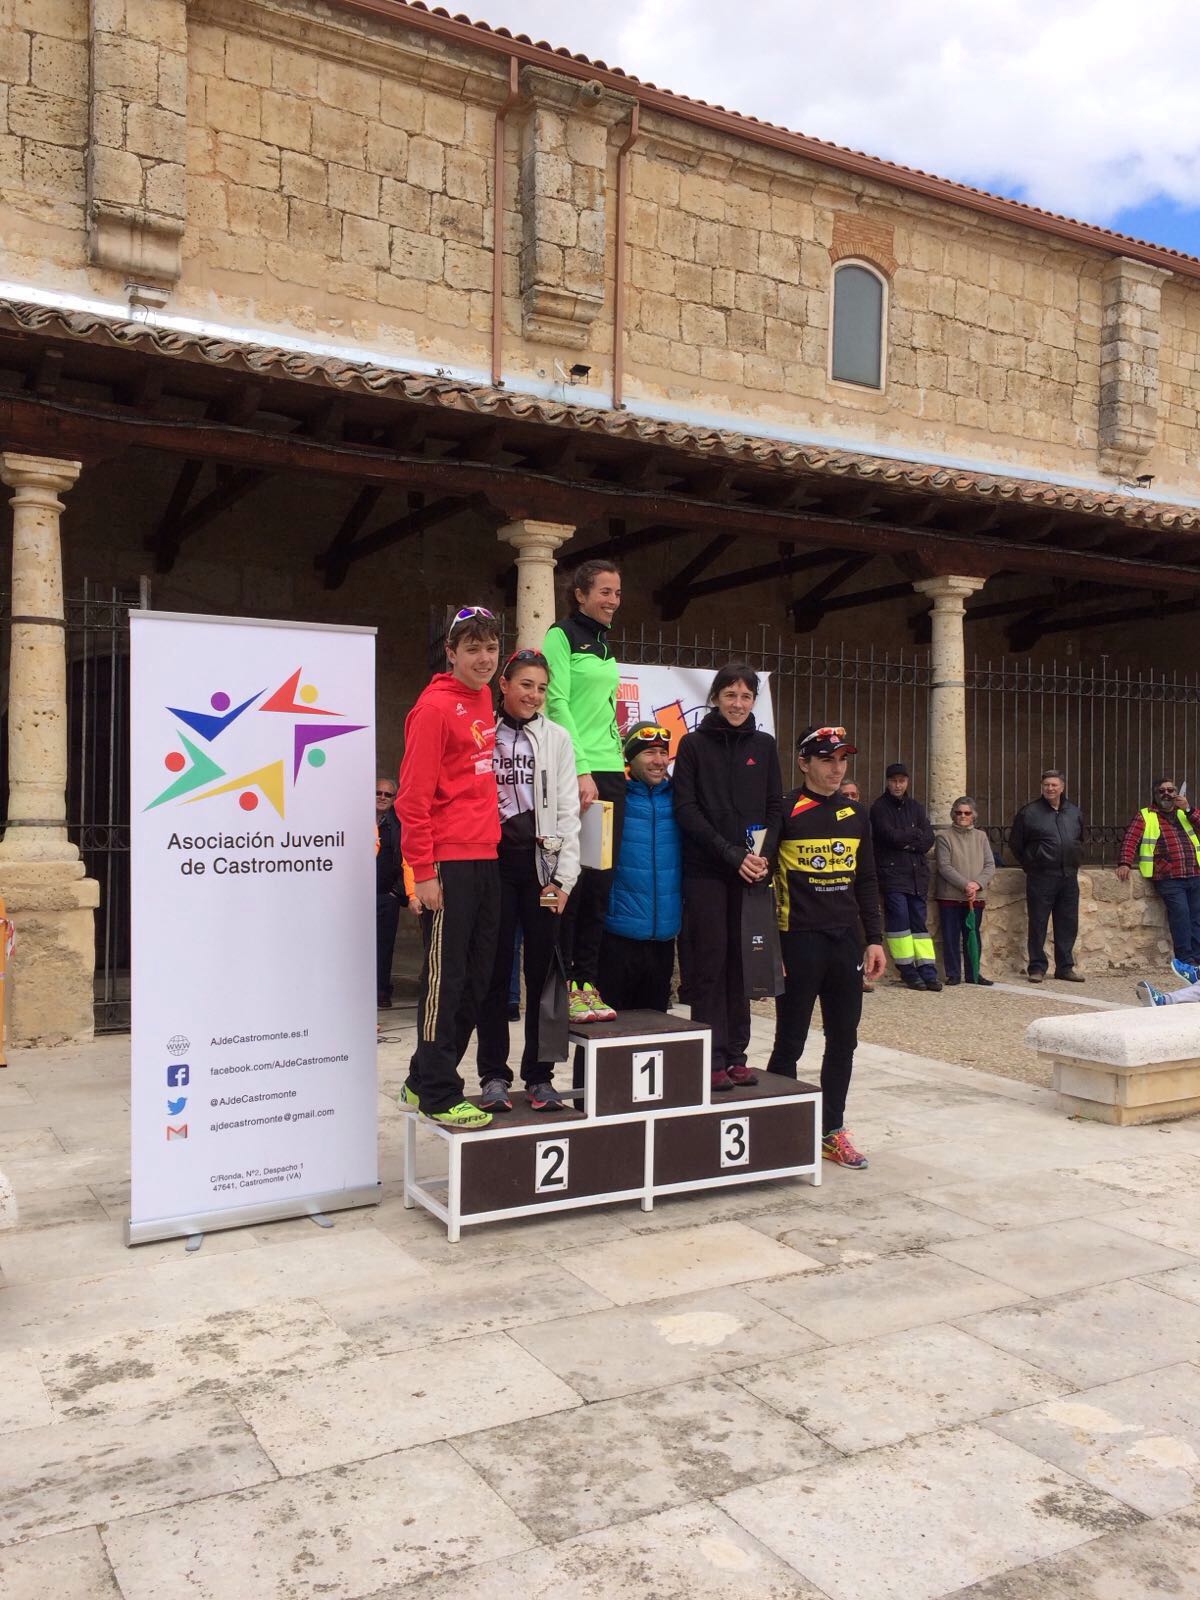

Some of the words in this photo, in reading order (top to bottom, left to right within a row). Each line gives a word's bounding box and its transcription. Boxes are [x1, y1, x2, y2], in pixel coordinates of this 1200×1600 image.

[616, 683, 638, 700] smo
[495, 769, 534, 785] uélla
[167, 832, 274, 850] Asociación
[280, 831, 345, 848] Juvenil
[180, 858, 206, 875] de
[213, 857, 333, 874] Castromonte
[210, 1053, 349, 1076] facebook.com/AJdeCastromonte
[640, 1056, 656, 1096] 1
[210, 1108, 335, 1133] ajdecastromonte@gmail.com
[724, 1123, 746, 1161] 3
[540, 1145, 564, 1187] 2
[239, 1174, 285, 1188] Castromonte
